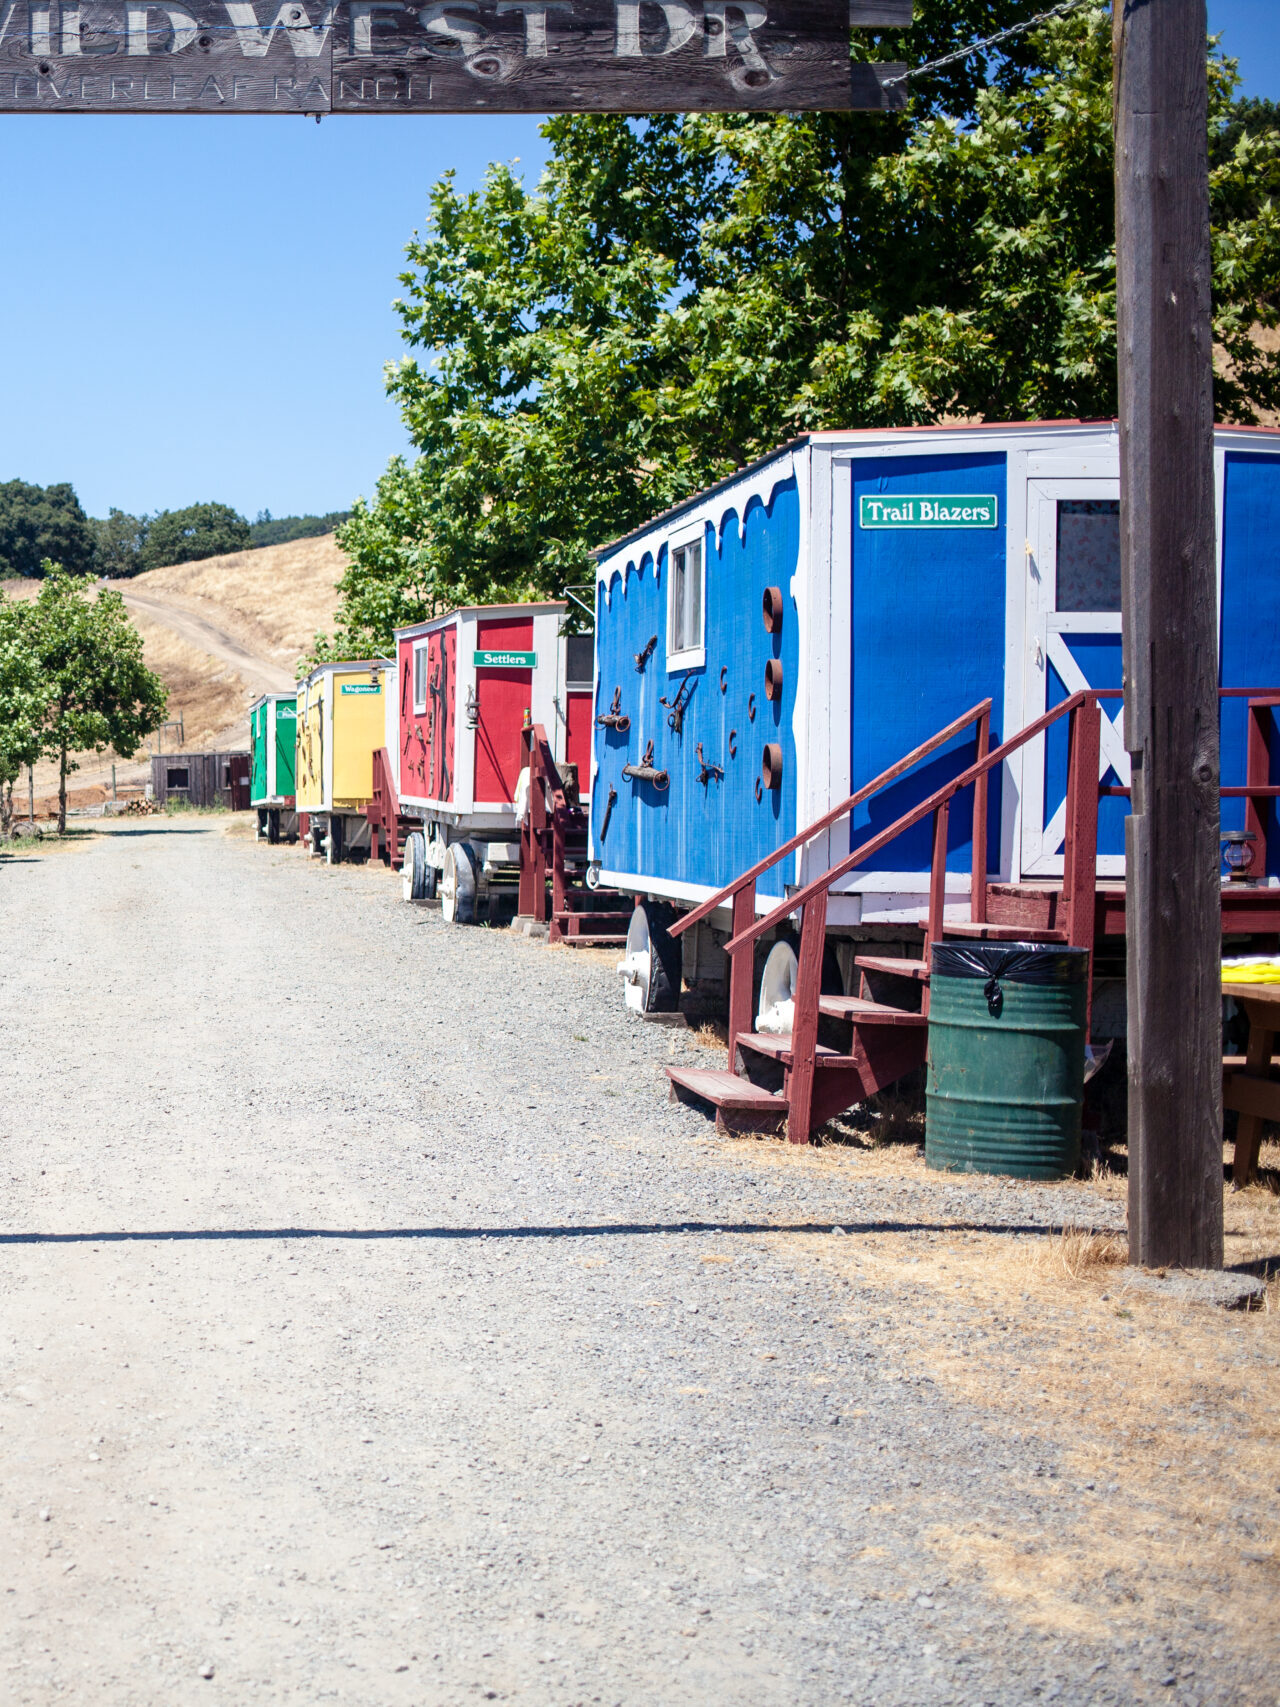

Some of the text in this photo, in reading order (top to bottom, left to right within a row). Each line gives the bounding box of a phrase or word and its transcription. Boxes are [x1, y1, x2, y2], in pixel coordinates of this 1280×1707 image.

[222, 0, 575, 58] WEST
[273, 74, 433, 100] RANCH
[867, 501, 990, 521] Trail Blazers
[483, 653, 527, 665] Settlers
